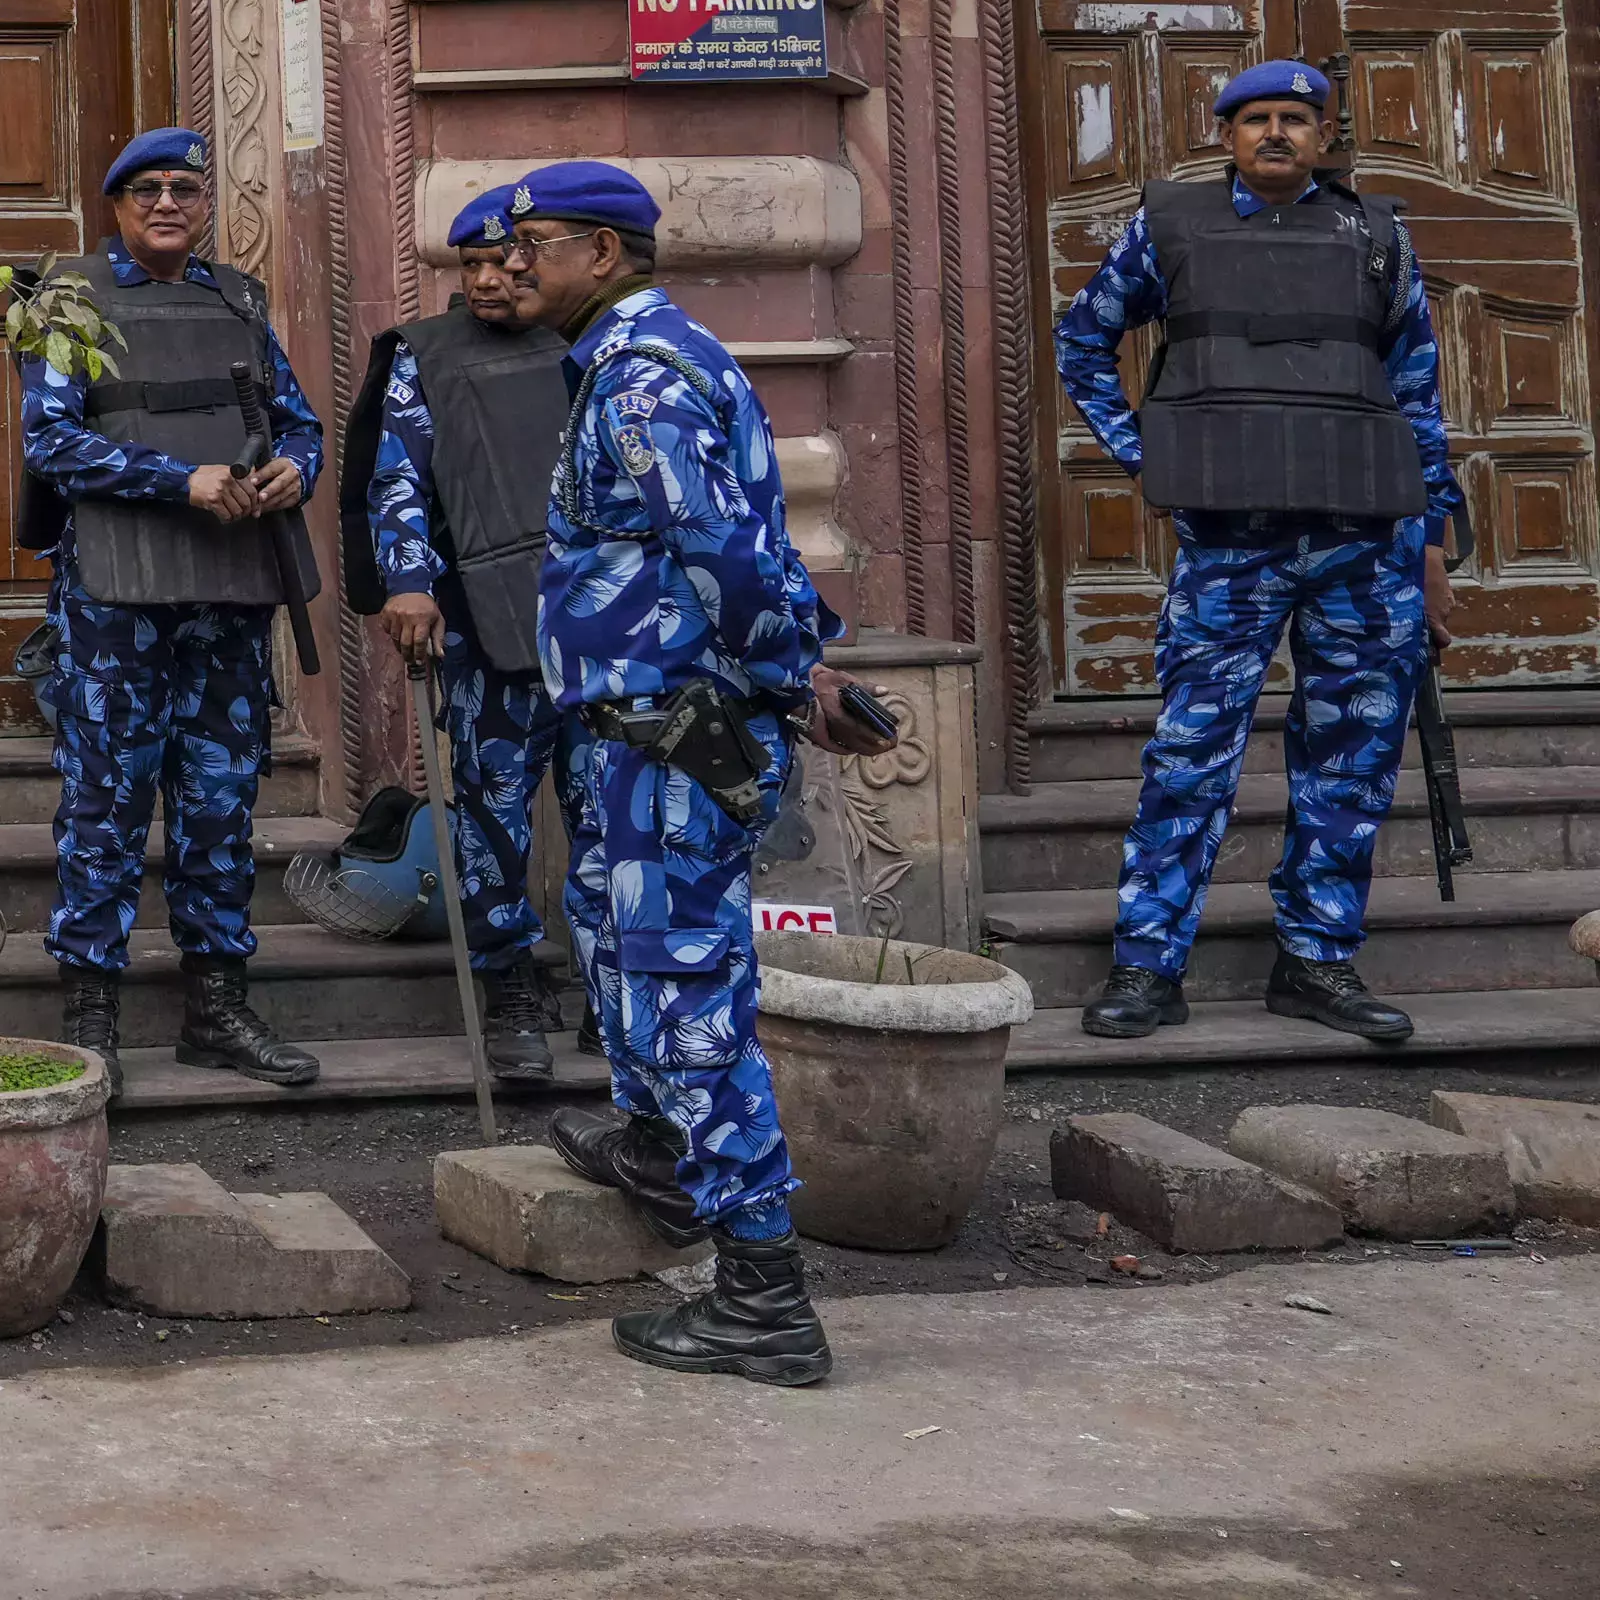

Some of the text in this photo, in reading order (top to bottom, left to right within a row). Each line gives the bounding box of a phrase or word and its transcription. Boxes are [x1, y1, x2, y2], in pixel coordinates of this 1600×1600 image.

[679, 37, 693, 54] के
[696, 41, 730, 55] समय
[733, 37, 768, 54] केवल
